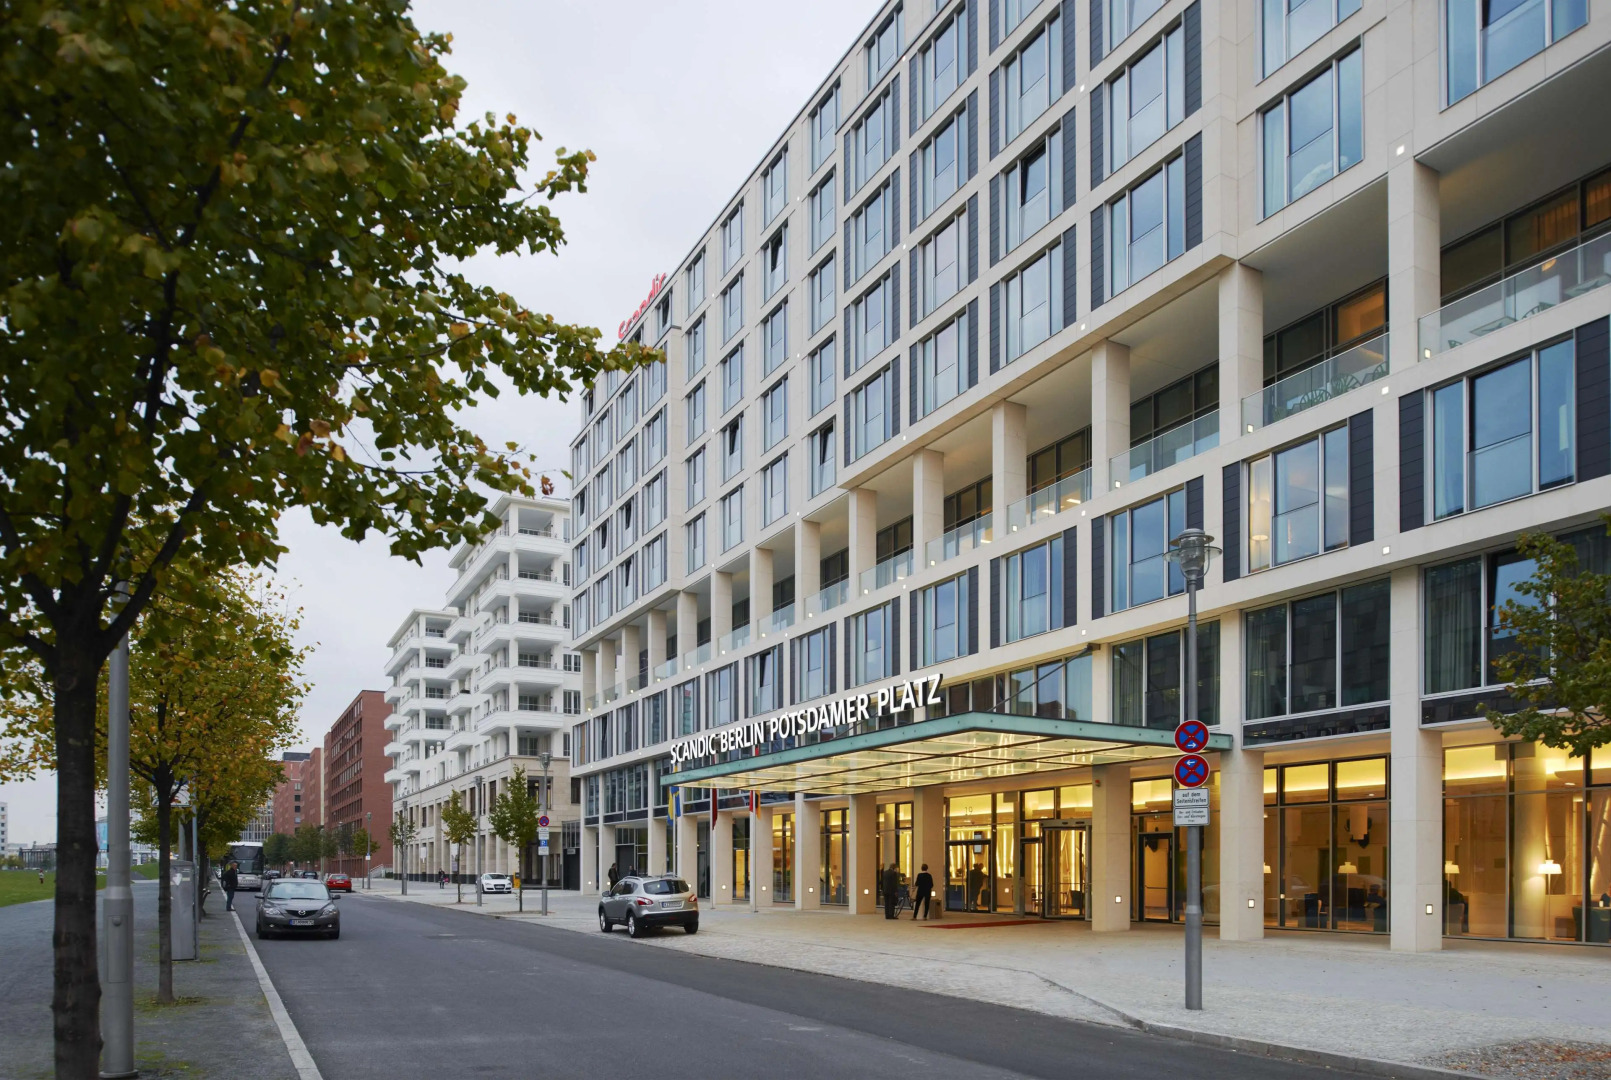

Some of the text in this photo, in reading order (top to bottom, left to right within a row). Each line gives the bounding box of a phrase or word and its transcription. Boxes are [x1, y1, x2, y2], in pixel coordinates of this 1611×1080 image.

[670, 673, 942, 764] SCANDIC BERLIN POTSDAMER PLATZ
